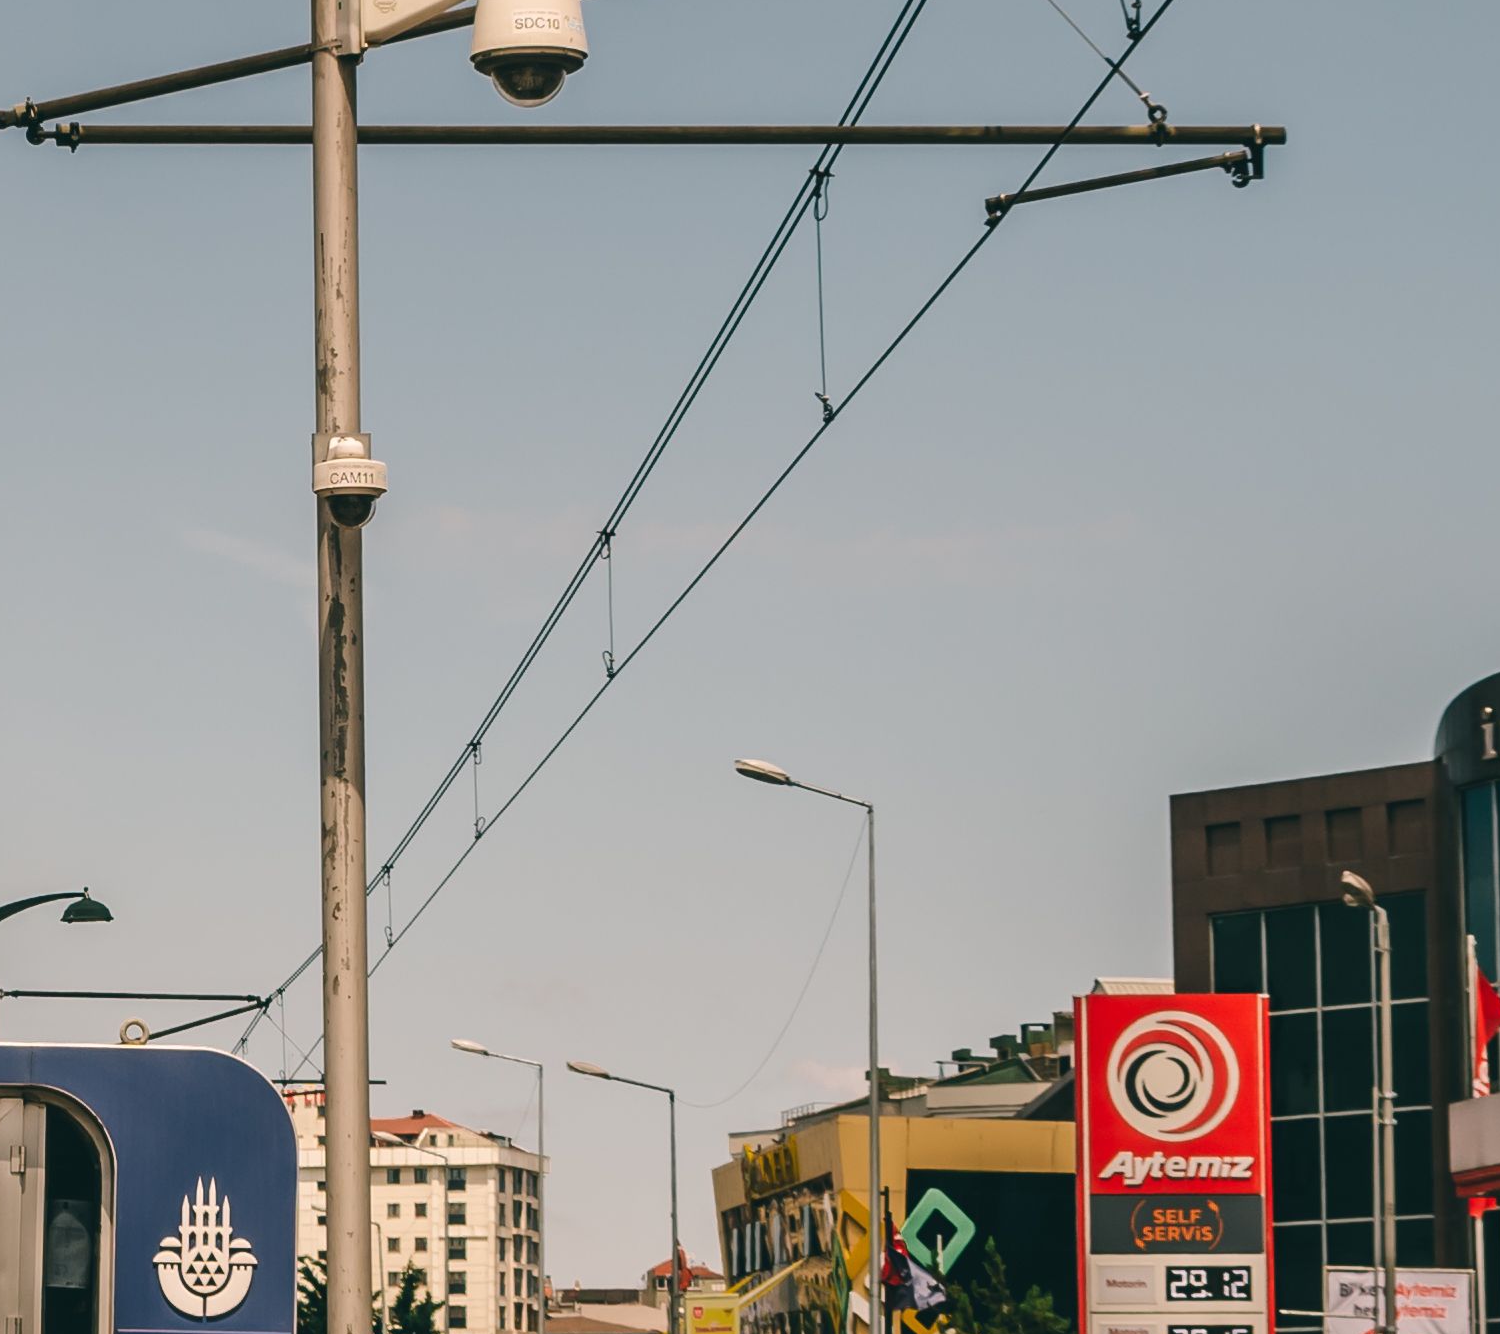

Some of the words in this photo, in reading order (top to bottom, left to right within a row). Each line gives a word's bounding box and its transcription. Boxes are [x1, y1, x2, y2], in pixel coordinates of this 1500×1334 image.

[514, 17, 560, 30] SDC10
[329, 471, 374, 485] CAM11
[1098, 1150, 1256, 1186] Aytemiz
[1152, 1208, 1203, 1225] SELF
